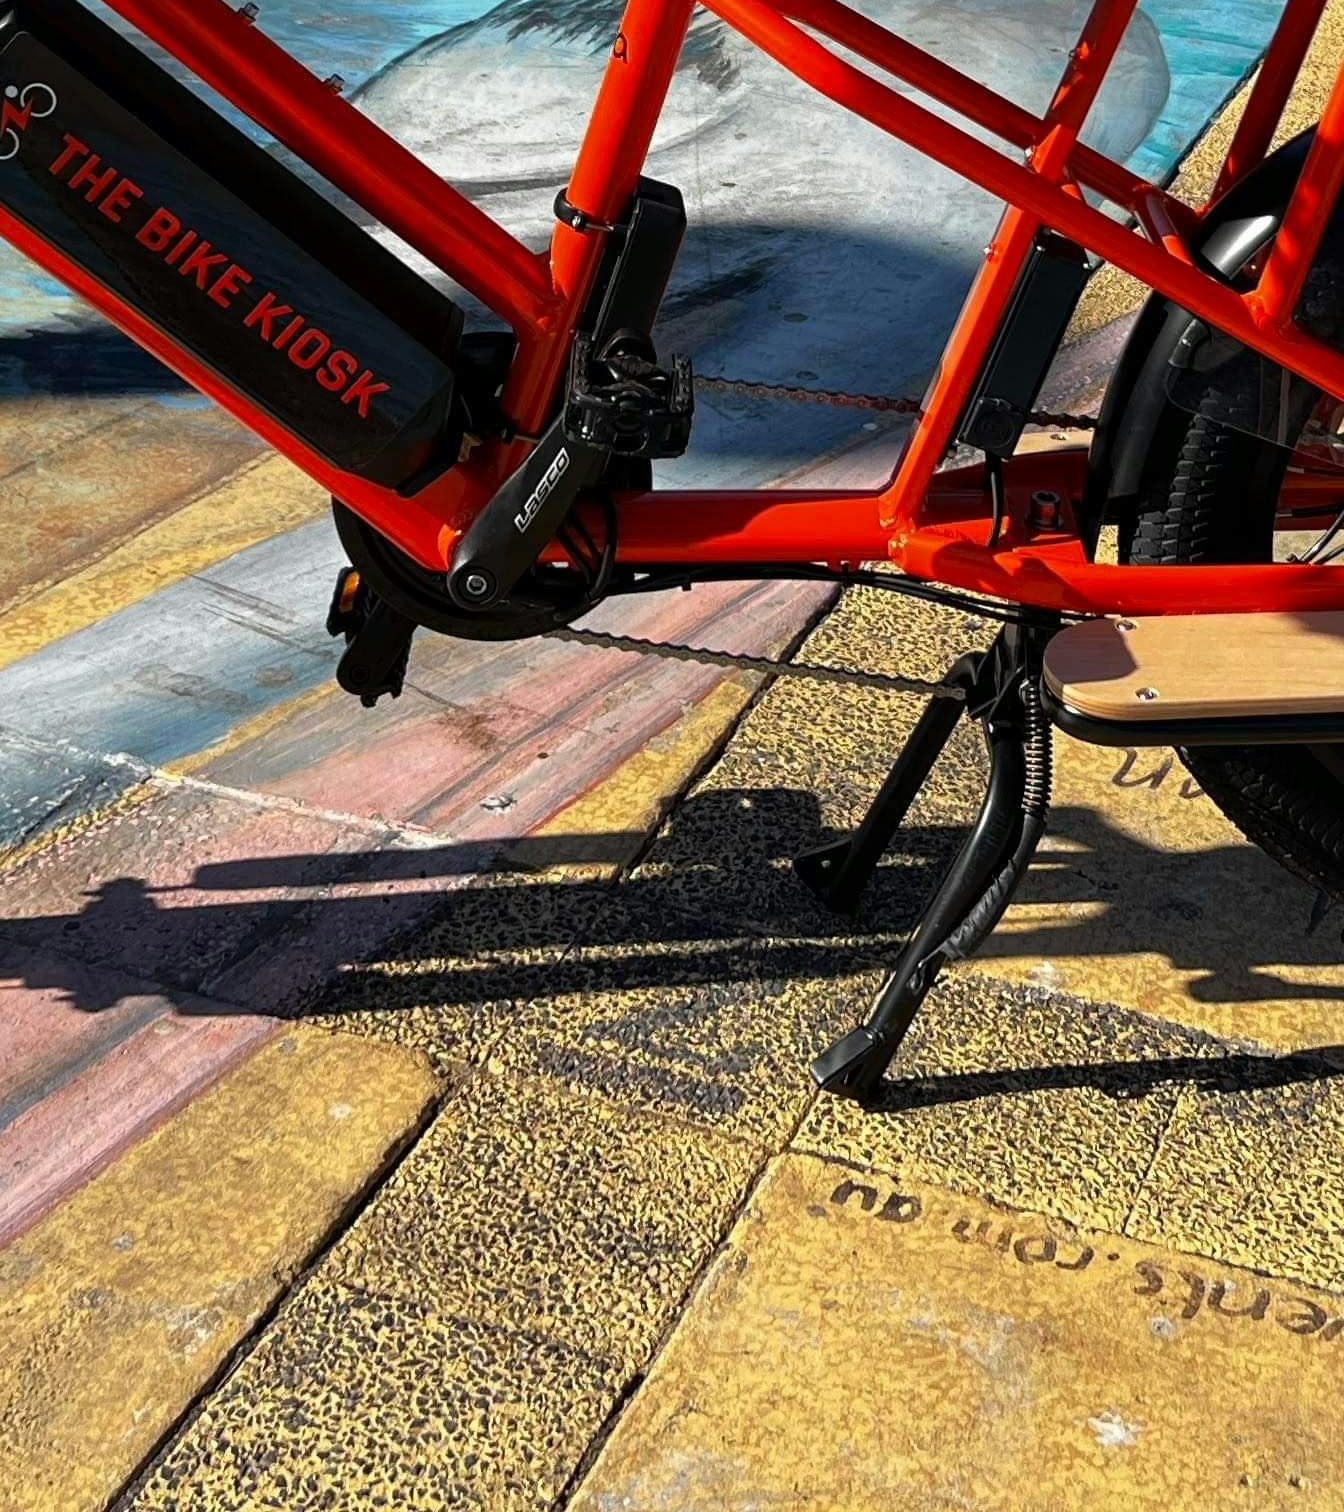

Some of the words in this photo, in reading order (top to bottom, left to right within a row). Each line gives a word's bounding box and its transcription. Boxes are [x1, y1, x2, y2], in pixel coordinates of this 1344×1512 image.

[49, 134, 143, 223] THE
[136, 207, 251, 308] BIKE
[242, 291, 390, 419] KIOSK
